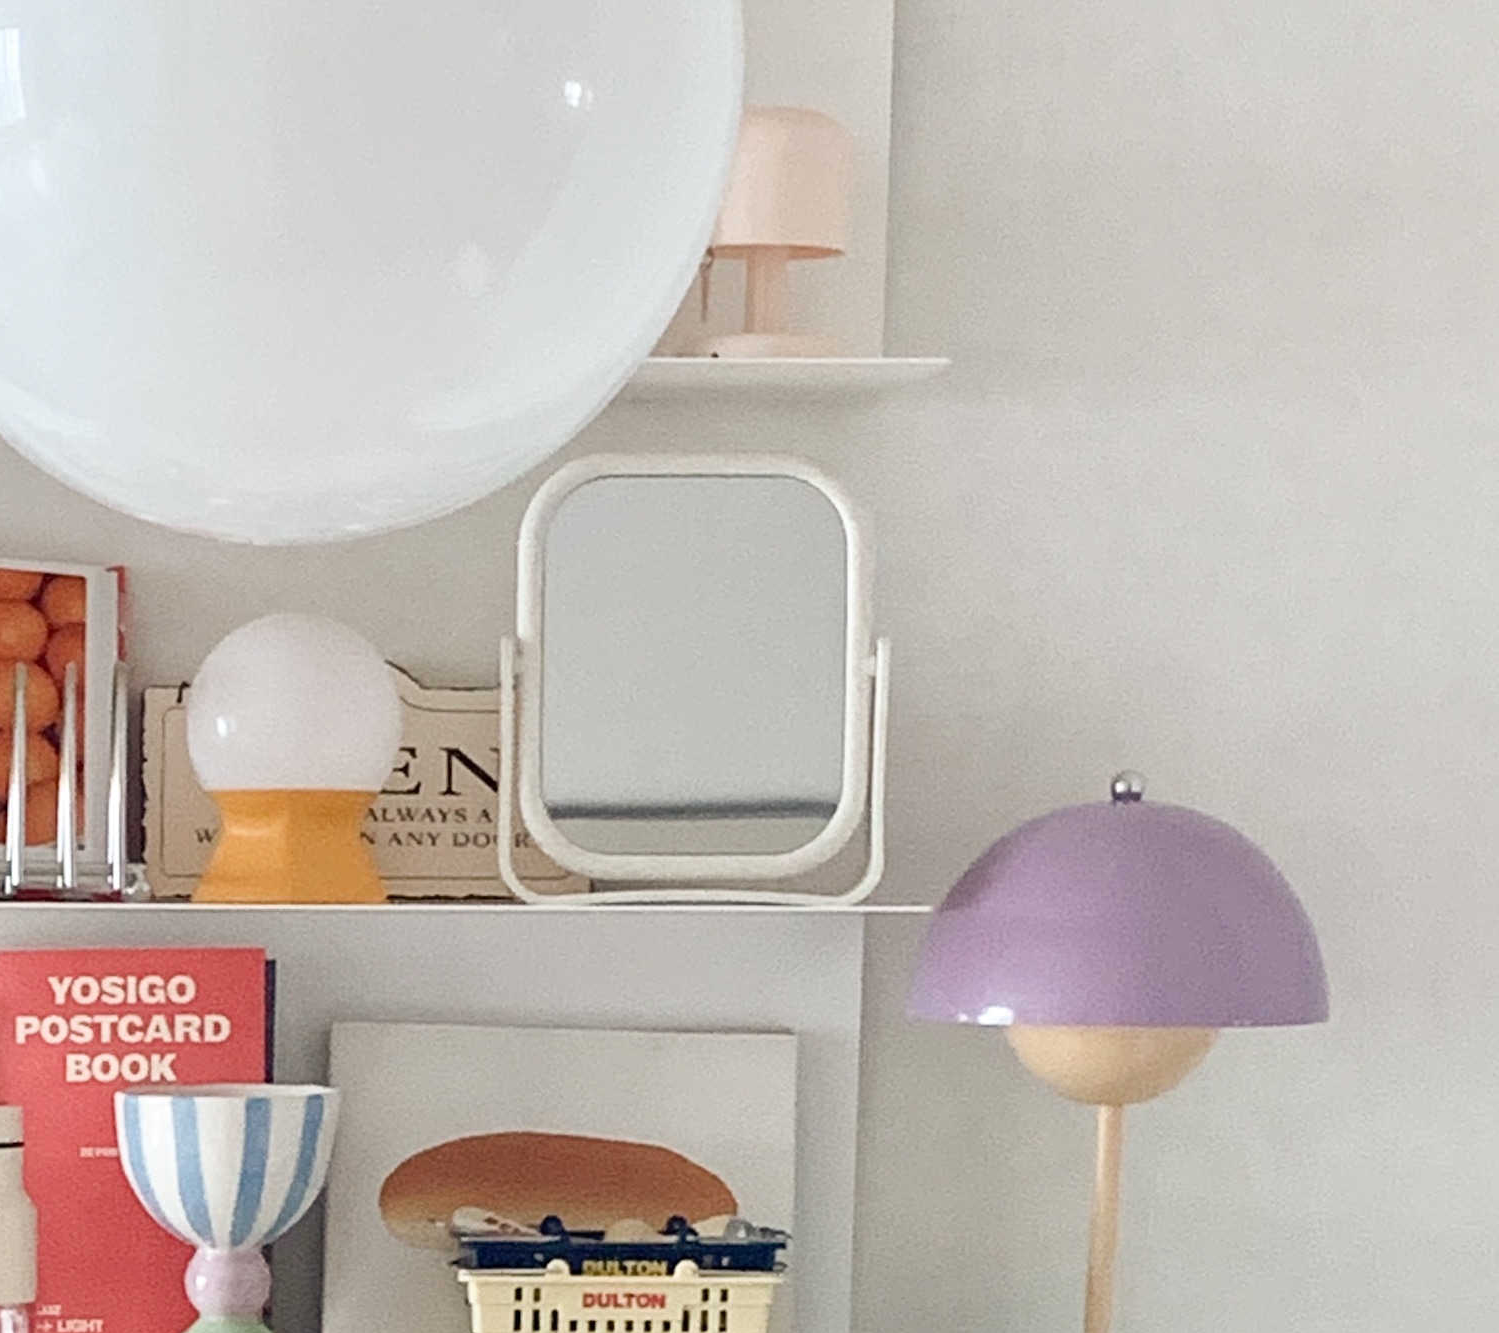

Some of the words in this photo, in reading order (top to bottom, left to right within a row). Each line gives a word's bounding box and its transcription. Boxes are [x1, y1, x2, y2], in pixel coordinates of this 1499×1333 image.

[364, 807, 467, 823] ALWAYS
[389, 832, 441, 846] ANY
[453, 832, 530, 848] DOR
[48, 975, 196, 1005] YOSIGO
[15, 1014, 231, 1043] POSTCARD
[66, 1053, 177, 1082] BOOK
[582, 1293, 666, 1309] DULTON
[57, 1319, 104, 1333] LIGHT
